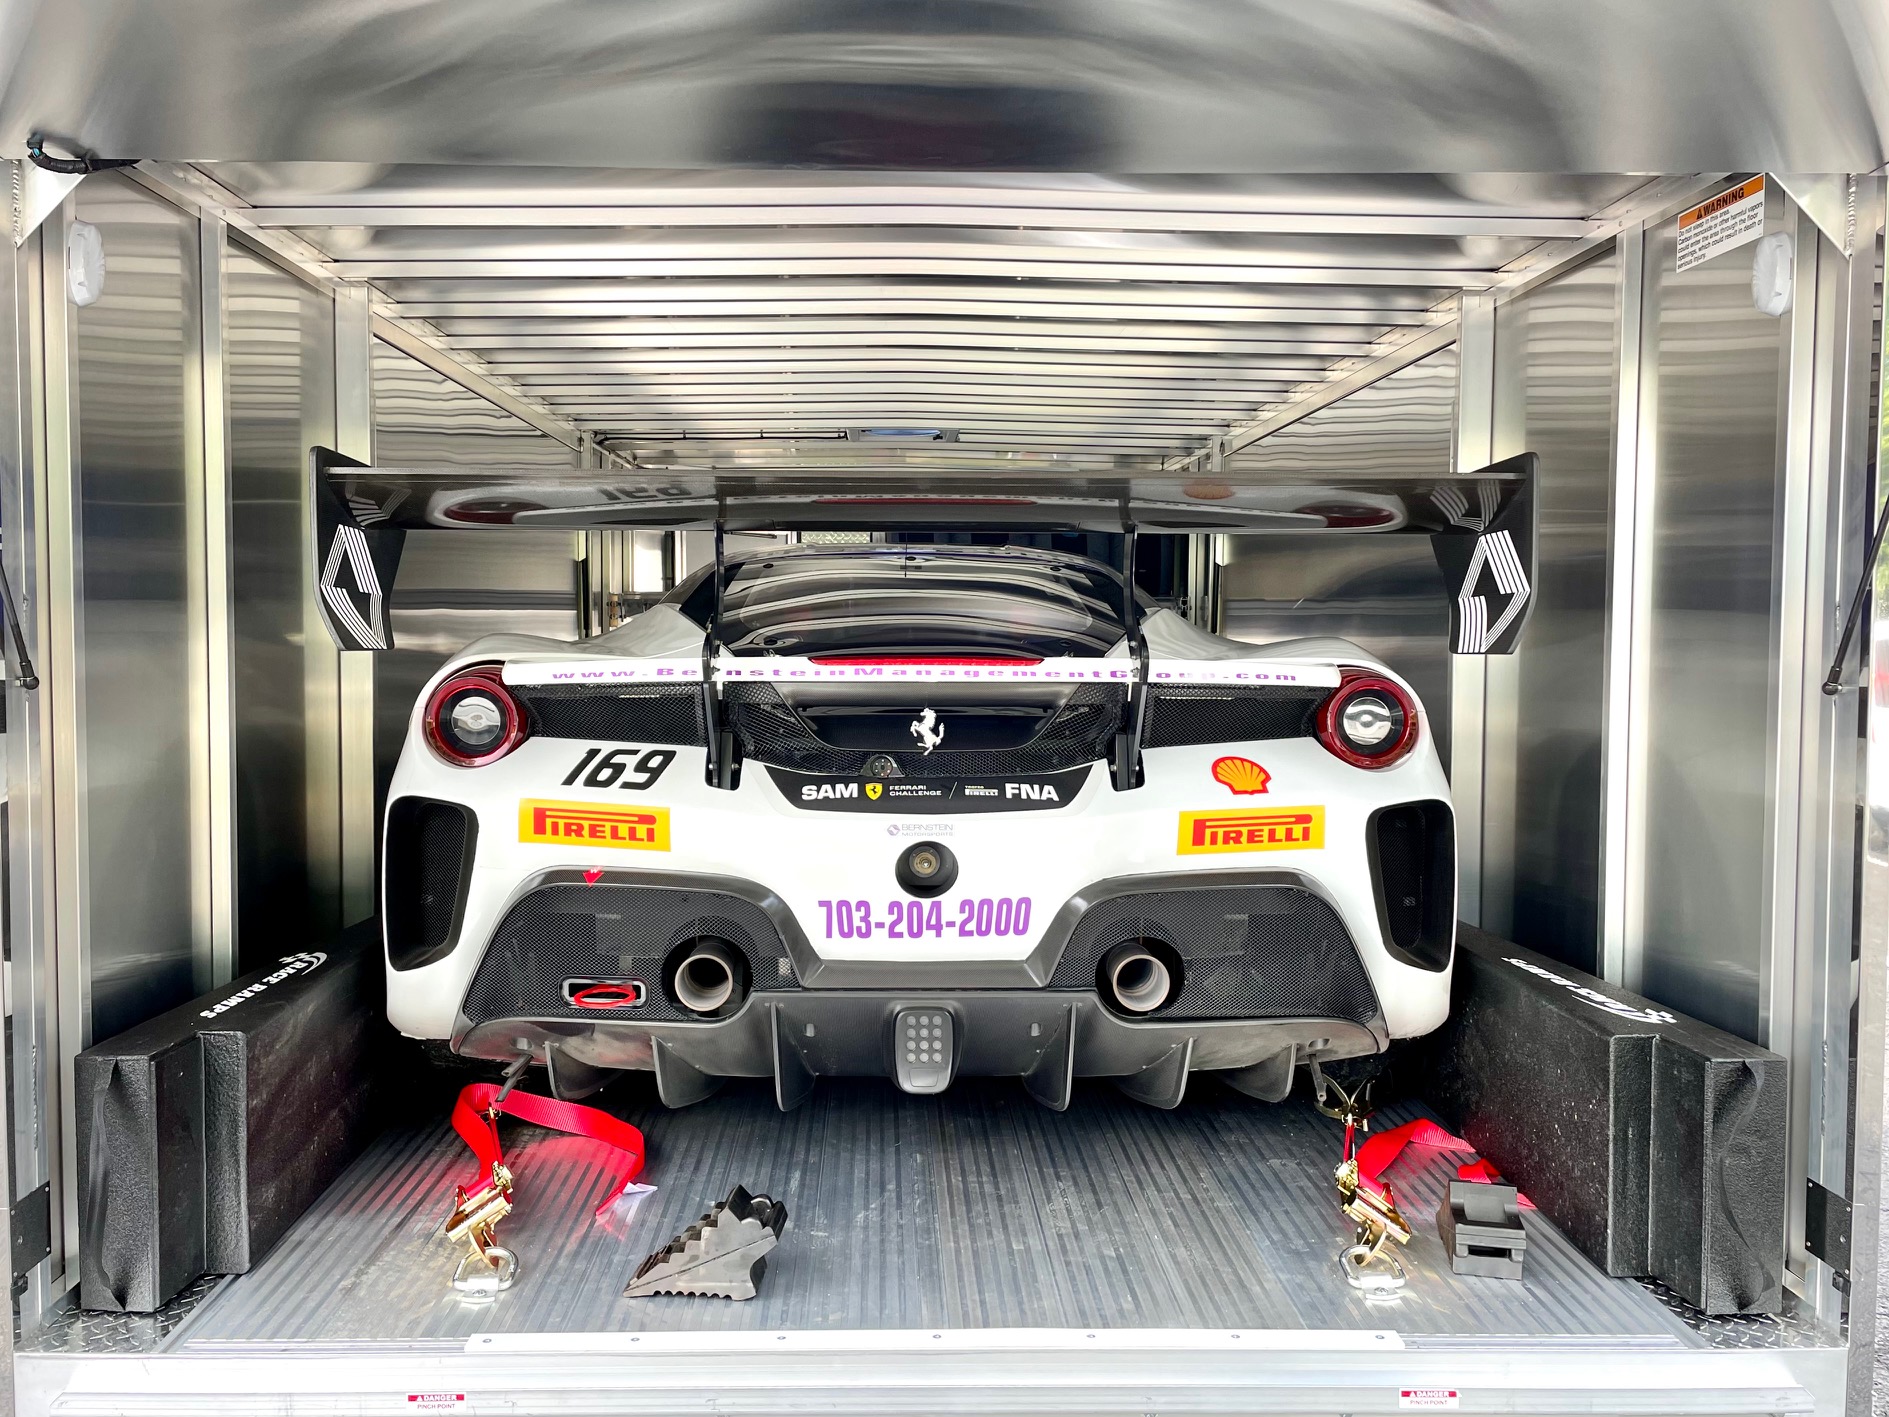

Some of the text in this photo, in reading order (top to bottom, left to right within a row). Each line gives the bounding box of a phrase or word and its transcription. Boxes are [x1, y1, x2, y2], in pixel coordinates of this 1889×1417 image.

[1703, 188, 1744, 216] WARNING
[560, 748, 677, 790] 169
[801, 783, 858, 800] SAM
[1004, 782, 1060, 801] FNA
[533, 806, 657, 842] PIRELLI
[1192, 814, 1313, 846] PIRELLI
[818, 897, 1032, 939] 703-204-2000
[200, 960, 309, 1019] RACE RAMPS
